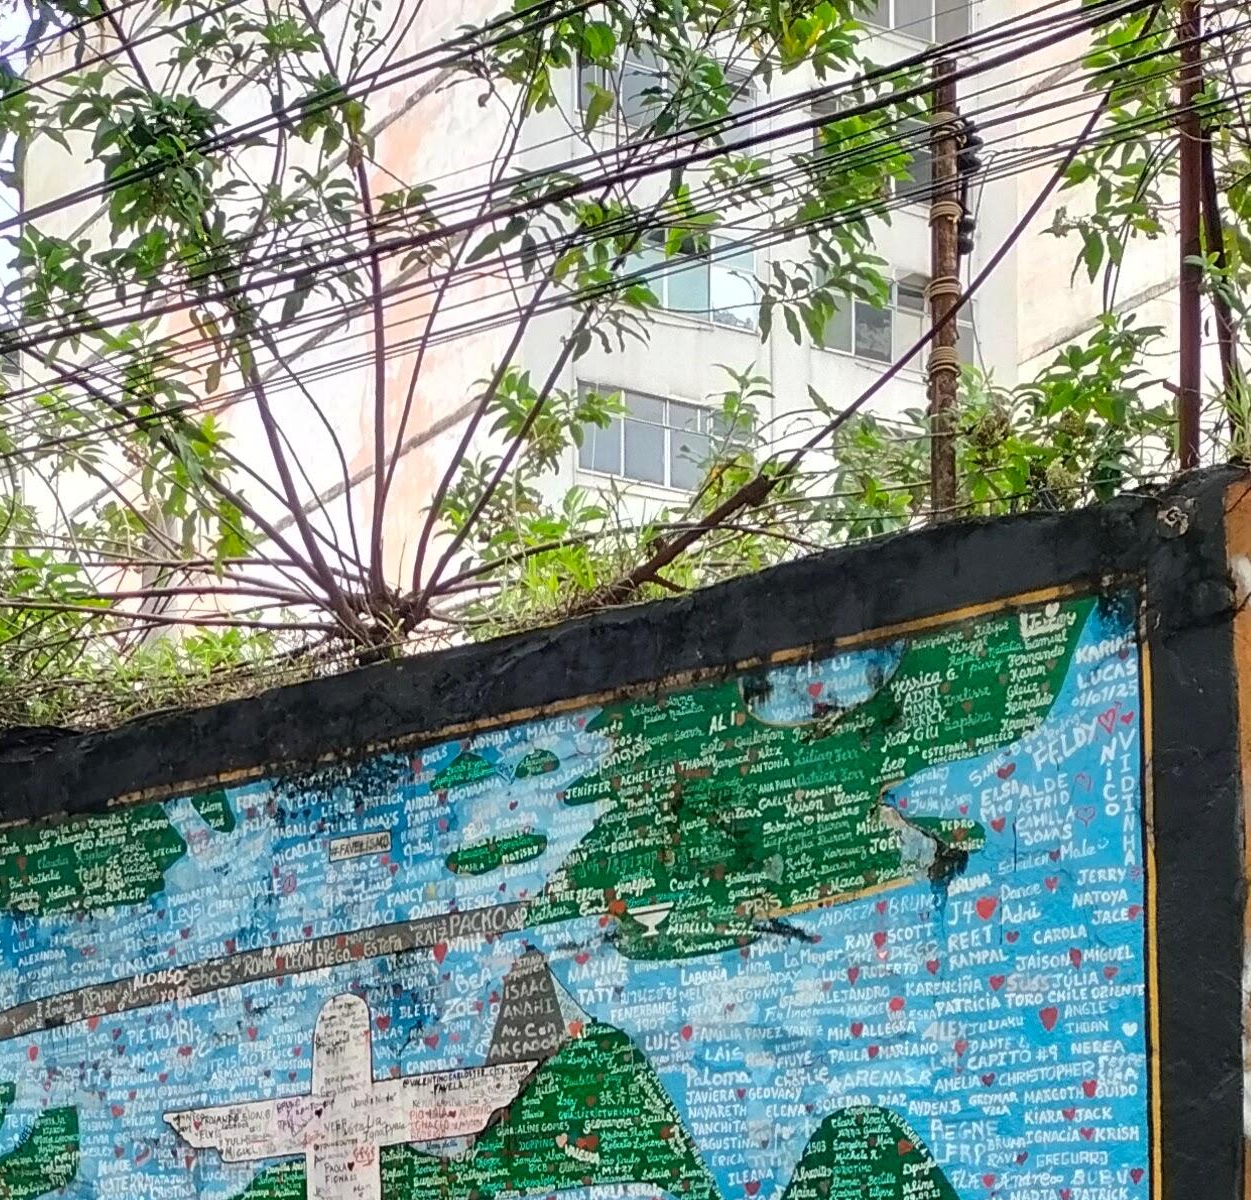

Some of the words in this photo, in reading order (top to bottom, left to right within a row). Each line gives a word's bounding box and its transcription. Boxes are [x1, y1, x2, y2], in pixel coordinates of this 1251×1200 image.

[1077, 661, 1137, 690] LUCAS
[1019, 824, 1072, 846] JONAS
[1077, 868, 1127, 885] JERRY
[1072, 889, 1128, 906] NATOYA
[1091, 909, 1129, 925] JACE
[888, 923, 934, 941] SCOTT
[1033, 925, 1087, 944] CAROLA
[844, 934, 874, 951] RAY
[949, 949, 1009, 971] RAMPAL
[505, 978, 548, 999] ISAAC
[817, 985, 890, 1004] ALEJANDRO
[828, 1048, 869, 1063] PAULA
[1071, 1040, 1125, 1055] NEREA
[998, 1061, 1095, 1087] CHRISTOPHER
[1074, 1107, 1113, 1122] JACK
